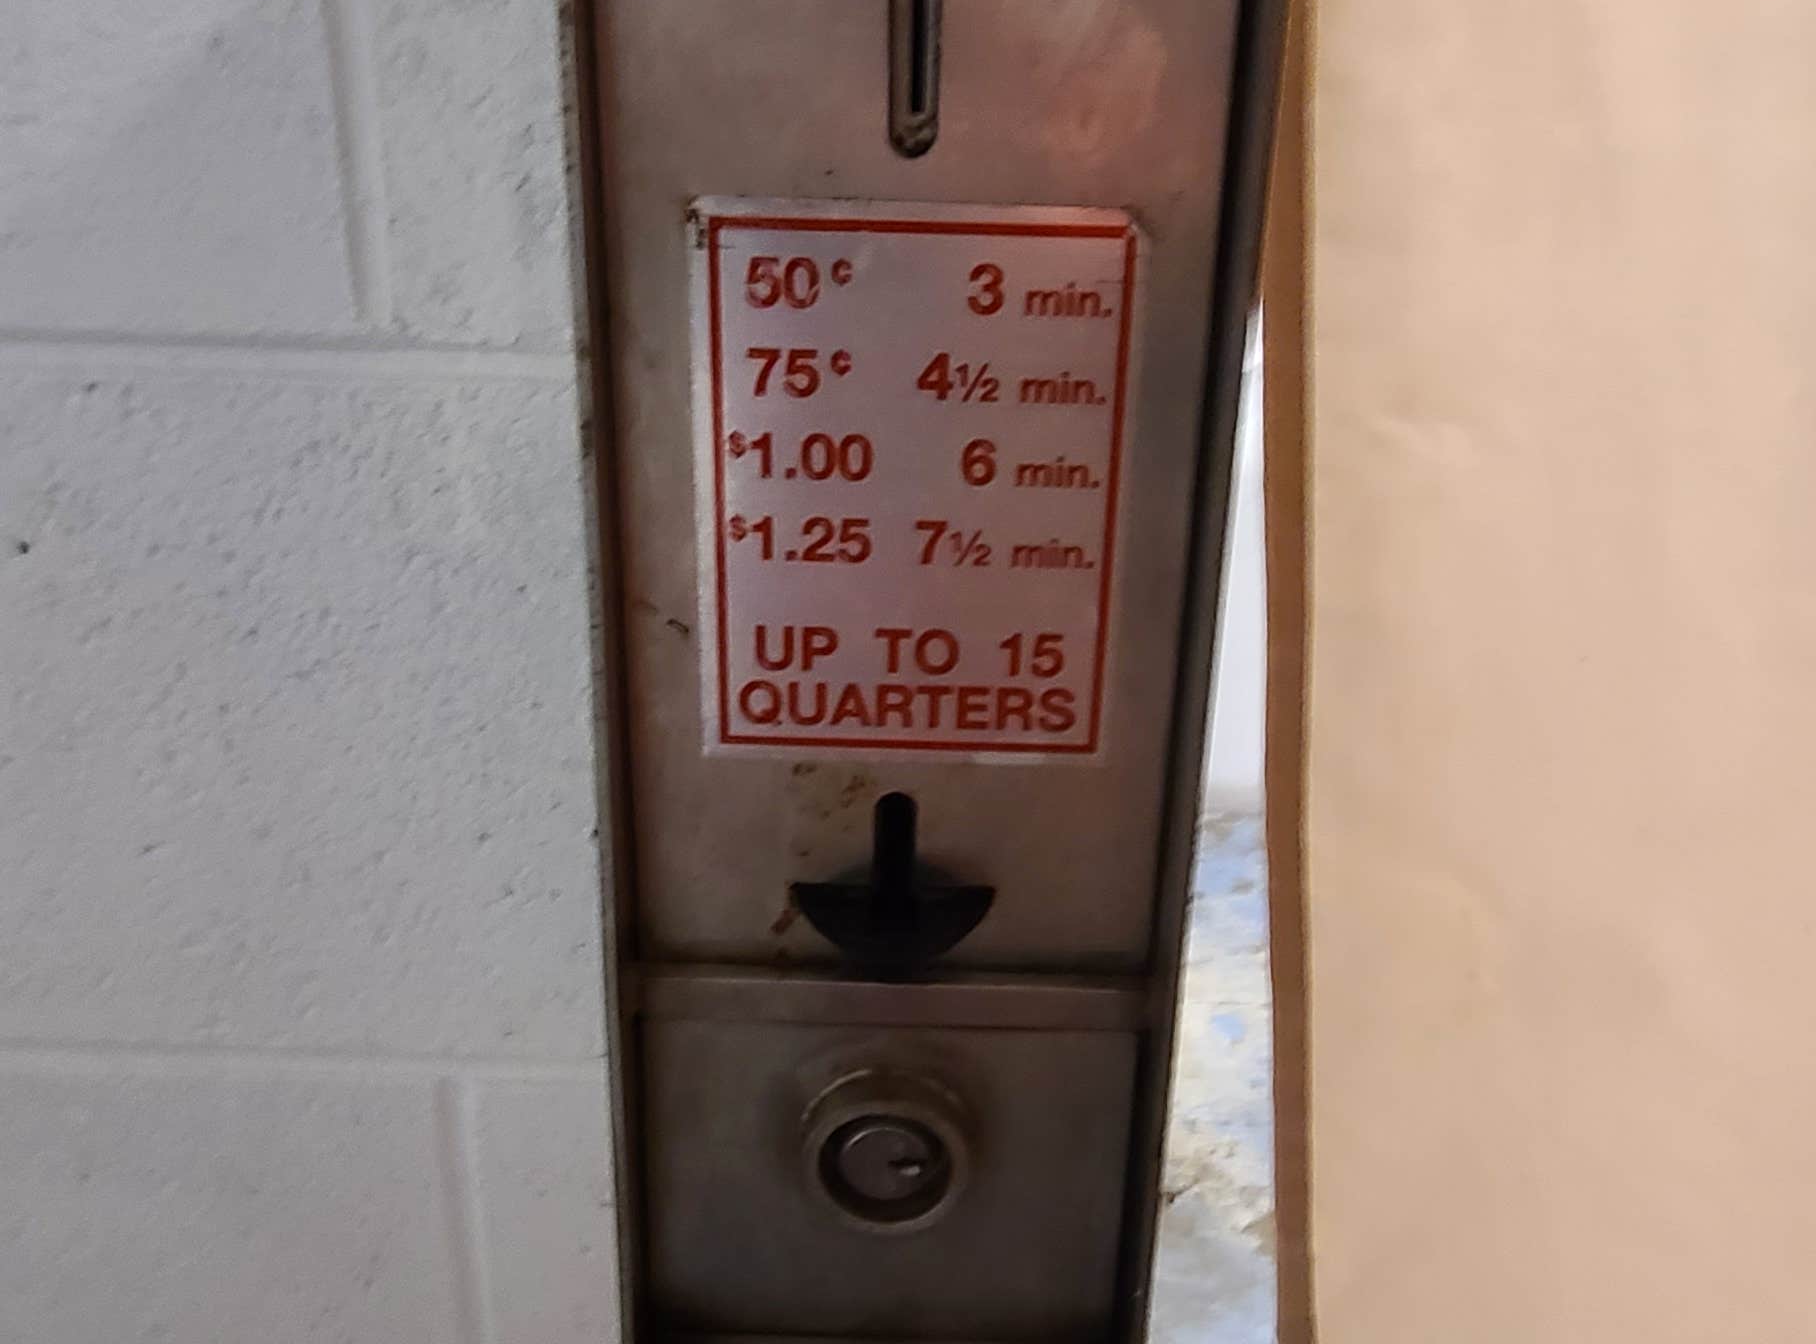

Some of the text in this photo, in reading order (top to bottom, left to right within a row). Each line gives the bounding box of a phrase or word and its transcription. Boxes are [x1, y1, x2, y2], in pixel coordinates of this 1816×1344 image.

[968, 264, 1004, 316] 3
[1024, 282, 1114, 319] min.
[1019, 372, 1107, 405] min.
[729, 431, 1100, 489] $1.00 6 min.
[730, 515, 872, 564] $1.25
[1010, 539, 1096, 569] min.
[756, 625, 1064, 678] UP TO 15
[740, 679, 1076, 733] QUARTERS
